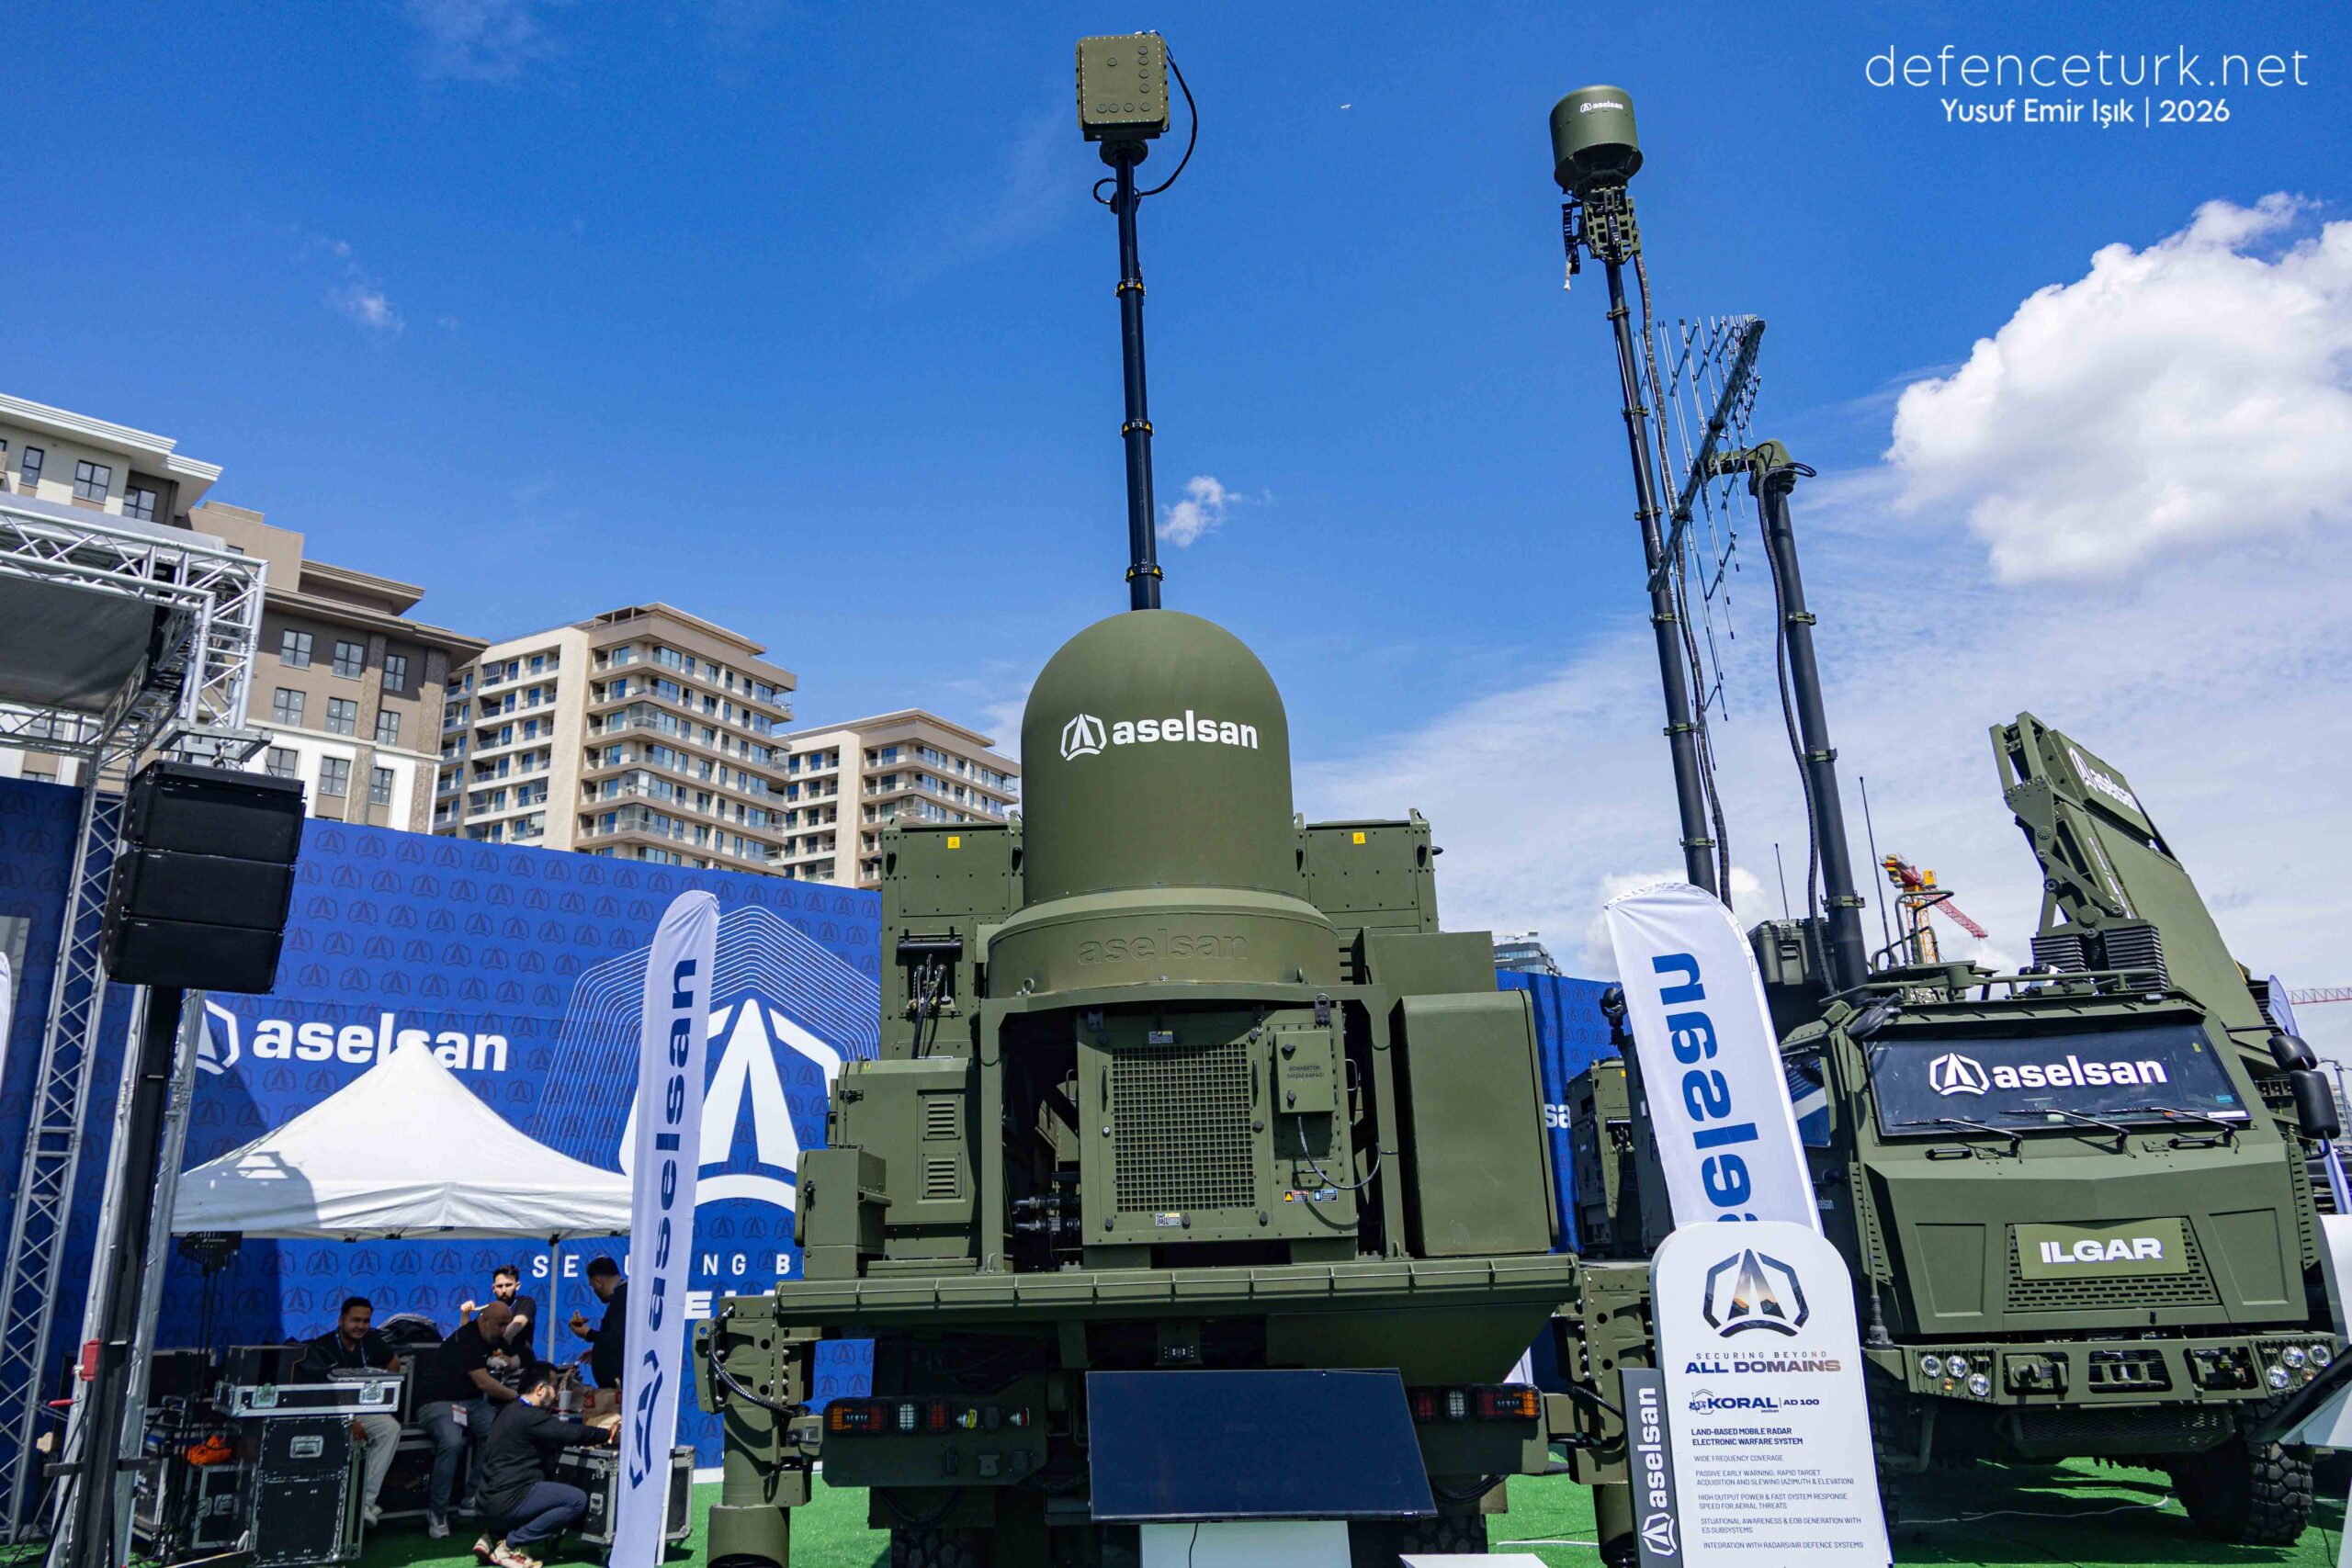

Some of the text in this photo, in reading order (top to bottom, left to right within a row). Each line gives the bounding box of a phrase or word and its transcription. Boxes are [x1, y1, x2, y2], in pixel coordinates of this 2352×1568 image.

[1113, 710, 1258, 750] aselsan
[1078, 928, 1249, 965] aselsan
[1993, 1055, 2167, 1089] aselsan
[650, 958, 696, 1332] aselsan
[2040, 1238, 2163, 1263] ILGAR
[1685, 1360, 1841, 1373] ALL DOMAINS
[1708, 1397, 1778, 1409] KORAL
[1638, 1388, 1668, 1507] aselsan
